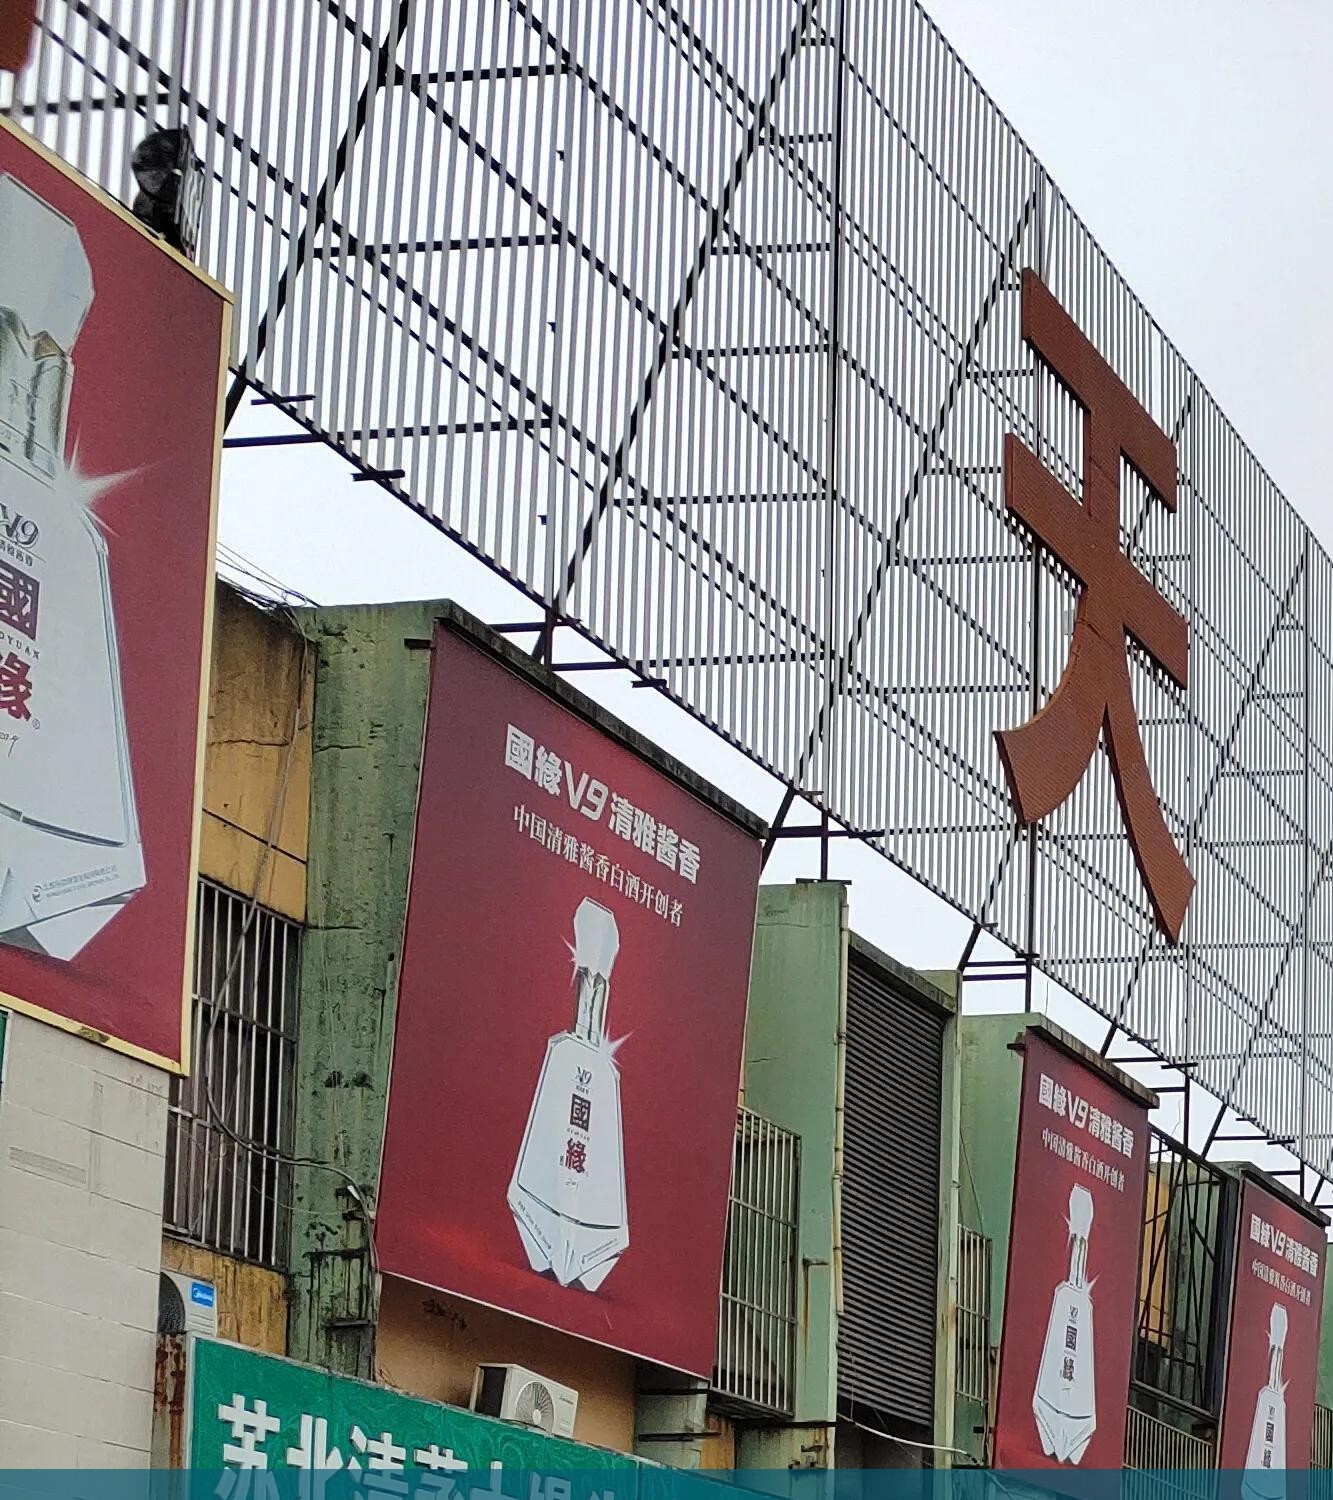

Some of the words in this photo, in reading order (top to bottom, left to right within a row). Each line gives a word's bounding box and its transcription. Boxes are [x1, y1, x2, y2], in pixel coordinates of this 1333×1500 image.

[513, 803, 684, 927] 中国清雅酱香白酒开创者
[608, 792, 701, 885] 清雅酱香
